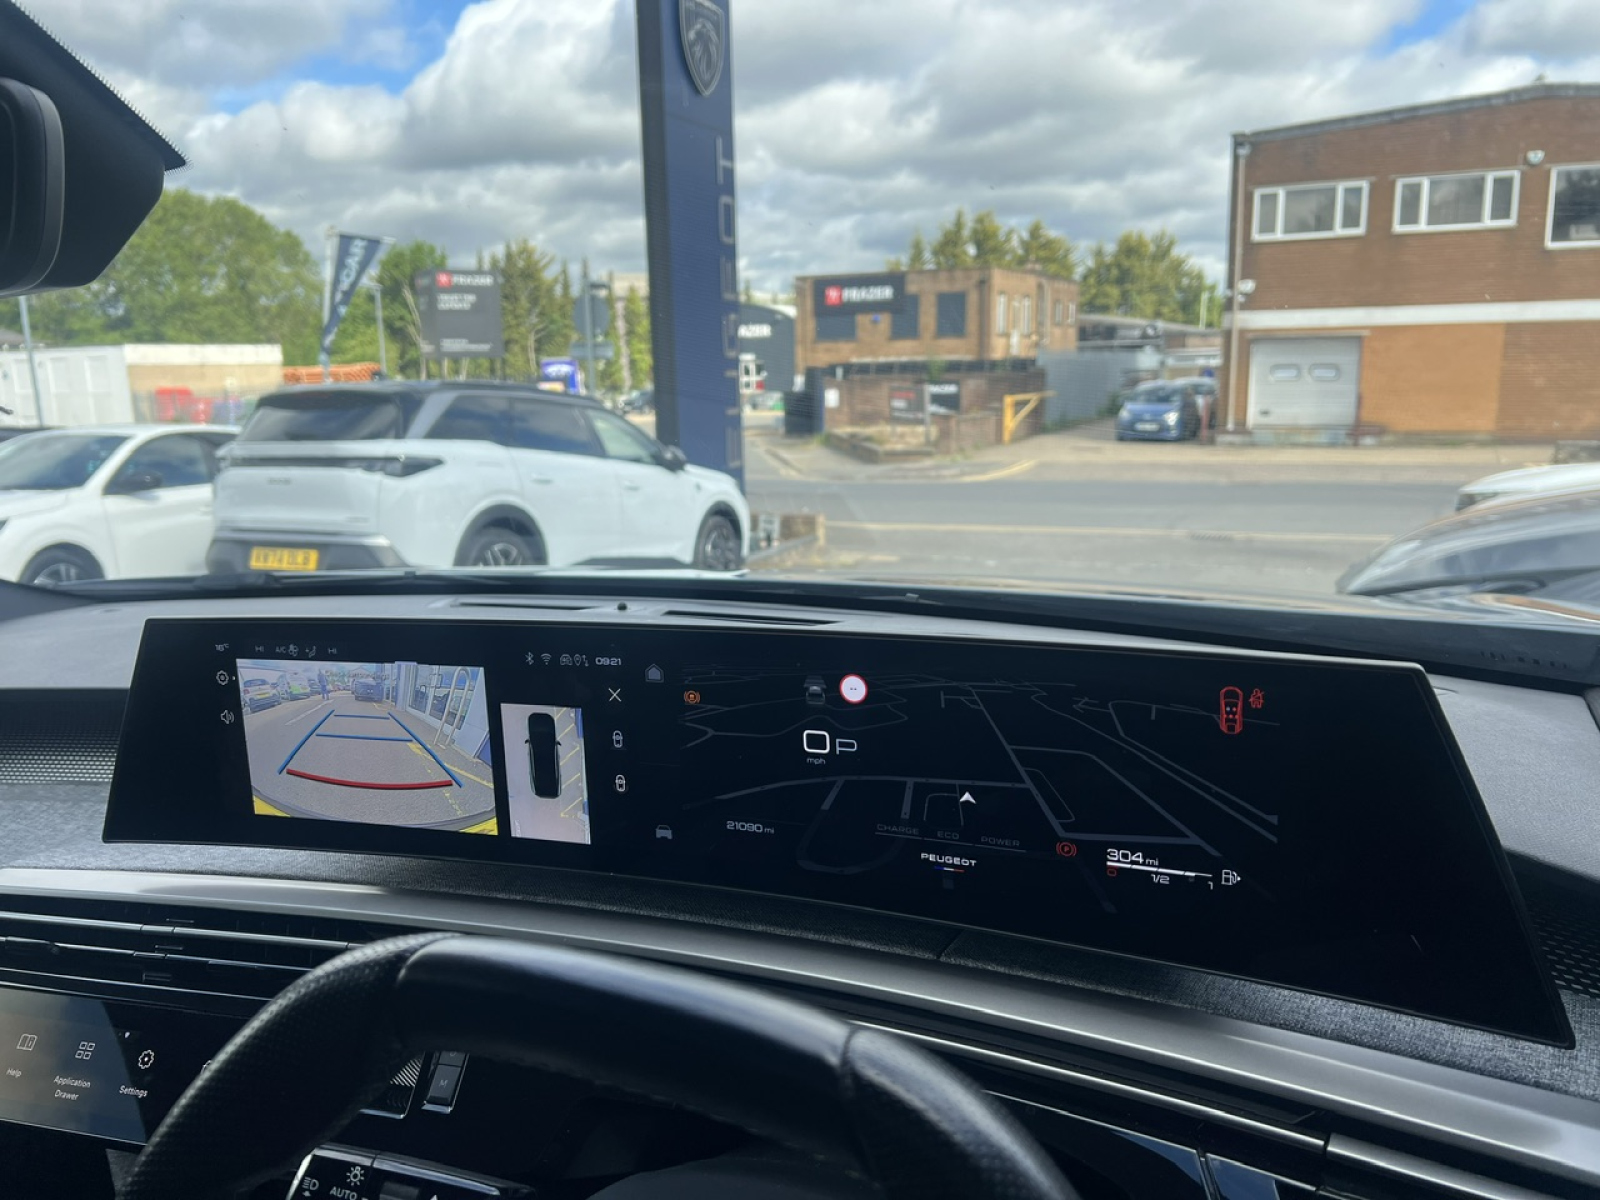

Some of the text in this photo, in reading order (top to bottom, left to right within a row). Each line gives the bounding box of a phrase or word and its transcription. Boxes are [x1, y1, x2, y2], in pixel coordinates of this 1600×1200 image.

[842, 285, 894, 302] FRAZER
[275, 646, 287, 654] A/C
[836, 738, 858, 755] P
[806, 756, 826, 765] mph
[726, 820, 775, 834] 21090 mi
[876, 823, 920, 836] CHARGE
[937, 830, 960, 840] ECO
[980, 835, 1020, 847] POWER
[920, 852, 977, 867] PEUGEOT
[1106, 848, 1159, 867] 304 mi
[1150, 873, 1170, 885] 1/2
[6, 1067, 22, 1078] Help
[53, 1074, 91, 1089] Application
[54, 1089, 80, 1101] Drawer
[119, 1084, 149, 1099] Settings
[329, 1186, 358, 1200] AUTO
